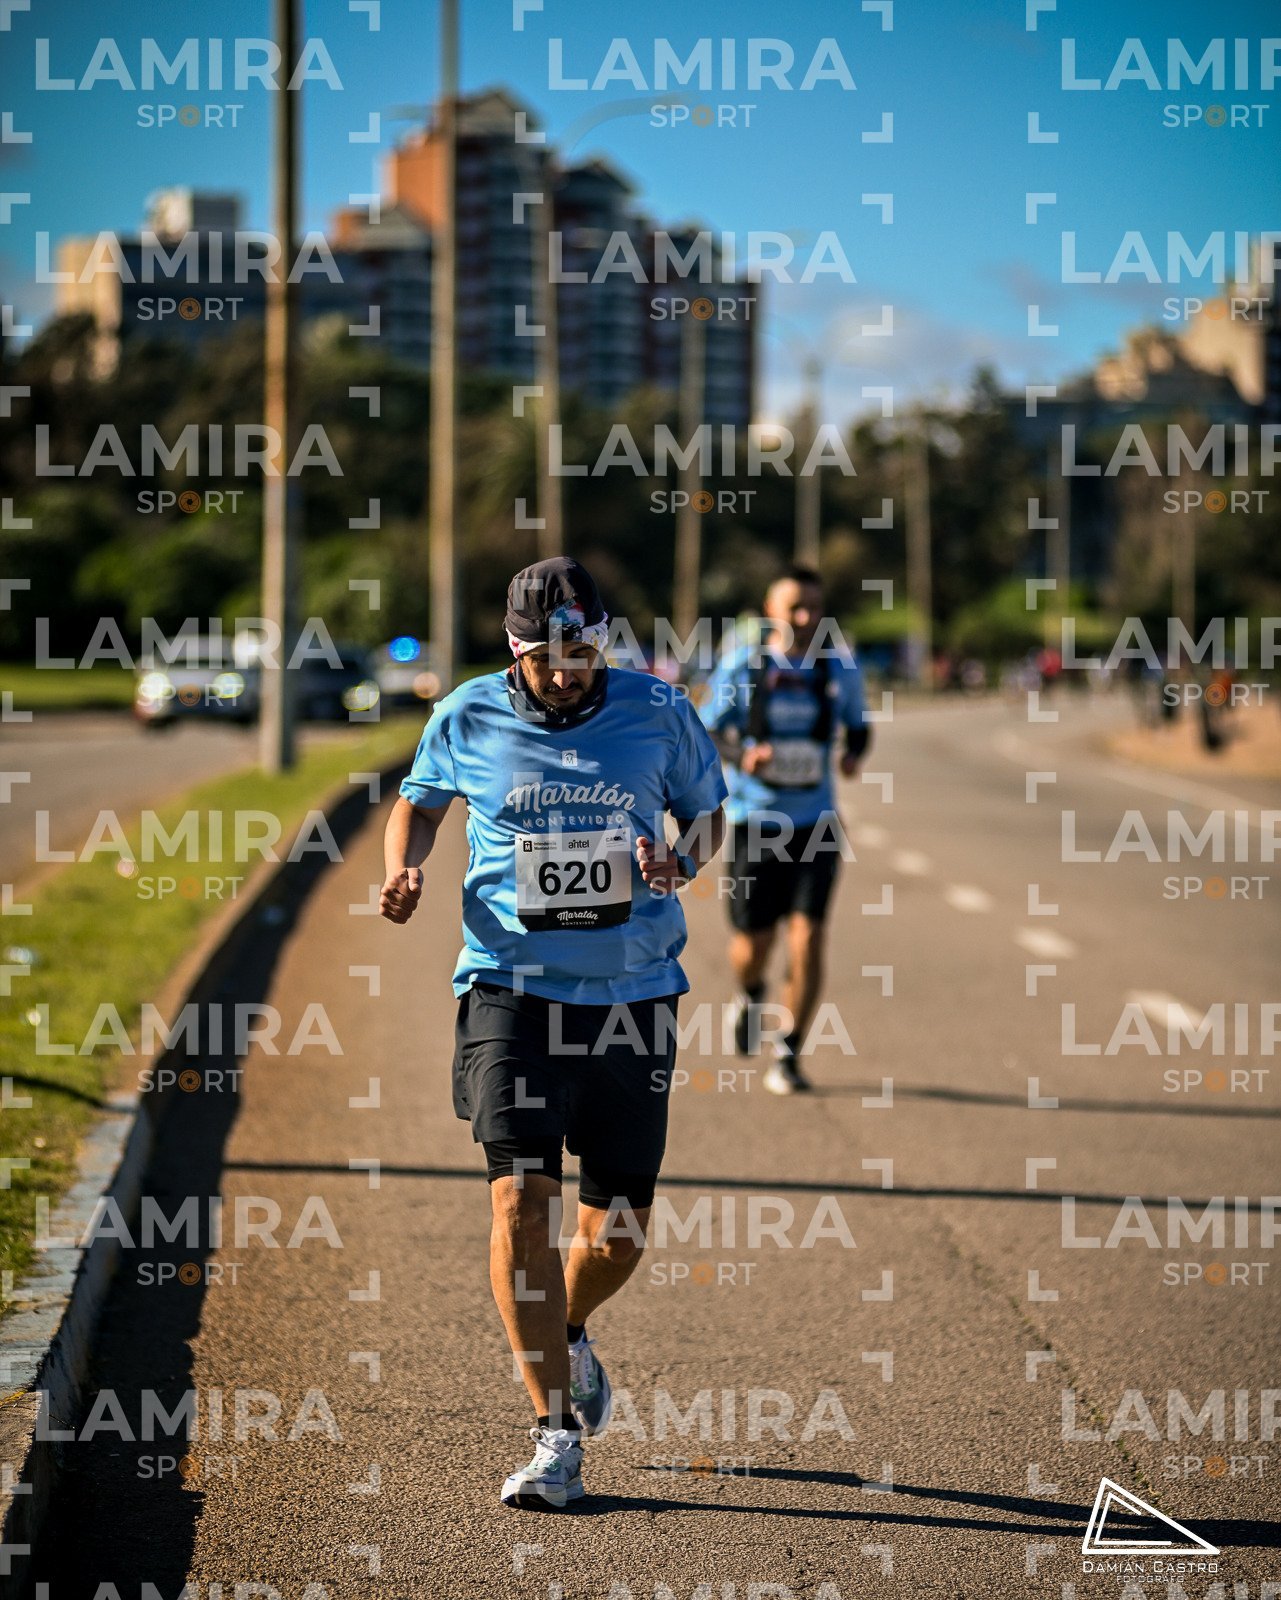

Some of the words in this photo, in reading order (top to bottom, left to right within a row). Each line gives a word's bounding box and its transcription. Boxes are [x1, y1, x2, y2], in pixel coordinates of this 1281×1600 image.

[505, 781, 636, 814] Maratón
[522, 814, 625, 829] MONTEVIDEO
[568, 839, 590, 849] antel
[538, 859, 612, 896] 620
[556, 910, 599, 921] Maratón
